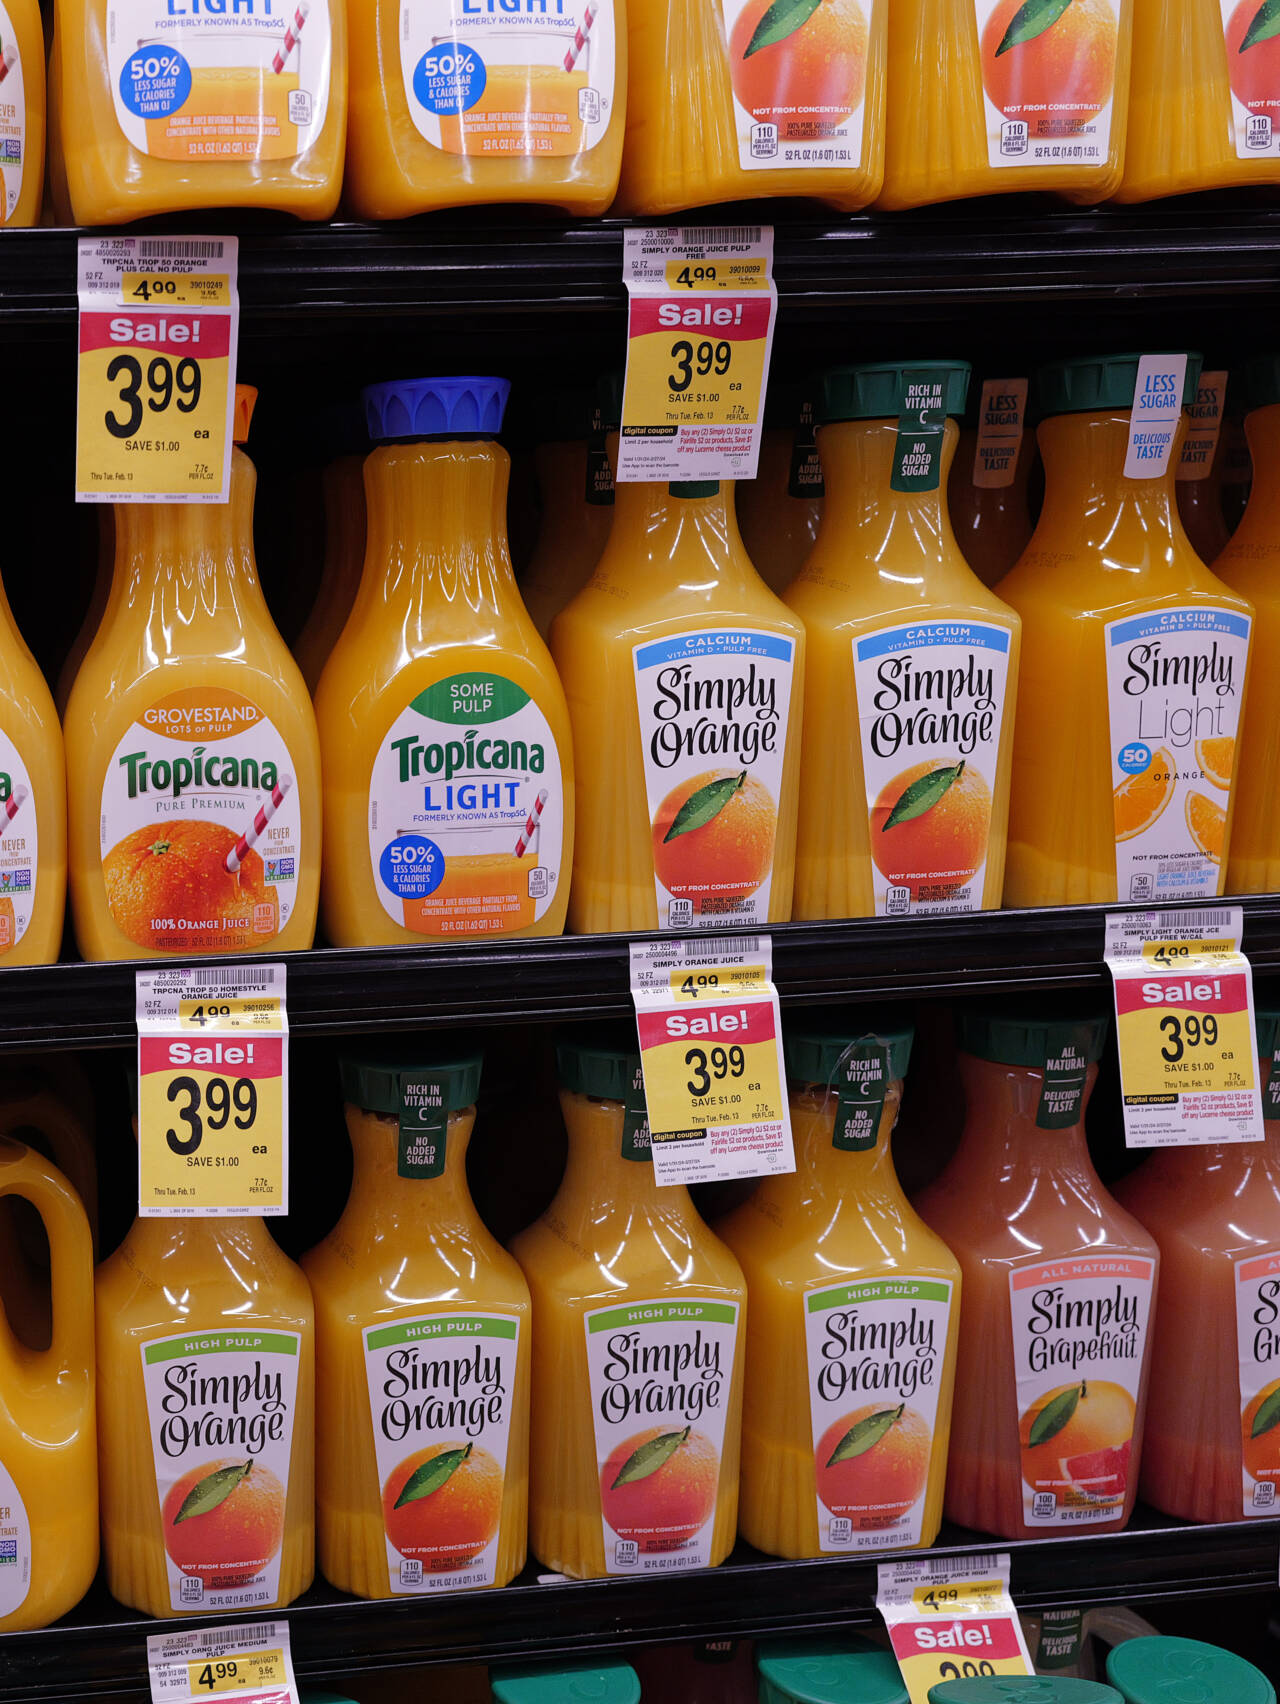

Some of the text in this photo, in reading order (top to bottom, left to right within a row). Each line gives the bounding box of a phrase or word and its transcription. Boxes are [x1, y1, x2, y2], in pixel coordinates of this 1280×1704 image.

[155, 18, 252, 29] FORMERLY KNOWN AS
[131, 56, 180, 79] 50%
[425, 53, 475, 77] 50%
[134, 78, 176, 91] LESS SUGAR
[135, 90, 175, 102] & CALORIES
[140, 101, 170, 112] THAN OJ
[798, 106, 852, 114] CONCENTRATE
[1004, 105, 1022, 113] NOT
[757, 127, 773, 137] 110
[641, 246, 670, 254] SIMPLY
[658, 304, 742, 326] Sale!
[109, 319, 200, 342] Sale!
[909, 384, 942, 396] RICH IN
[1145, 375, 1176, 392] LESS
[905, 397, 942, 409] VITAMIN
[1139, 394, 1176, 409] SUGAR
[919, 410, 929, 424] C
[624, 427, 674, 435] digital coupon
[1133, 433, 1170, 444] DELICIOUS
[125, 441, 180, 451] SAVE $1.00
[913, 443, 926, 453] NO
[1136, 445, 1164, 459] TASTE
[902, 454, 931, 465] ADDED
[901, 465, 929, 476] SUGAR
[686, 636, 751, 647] CALCIUM
[906, 628, 970, 639] CALCIUM
[1123, 641, 1235, 696] Simply
[450, 683, 494, 697] SOME
[874, 654, 996, 711] Simply
[653, 664, 779, 720] Simply
[453, 700, 492, 713] PULP
[144, 707, 259, 725] GROVESTAND
[1139, 697, 1224, 747] Light
[871, 708, 993, 757] Orange
[651, 717, 776, 768] Orange
[391, 730, 544, 783] Tropicana
[1123, 750, 1148, 762] 50
[120, 747, 277, 799] Tropicana
[1154, 771, 1205, 781] ORANGE
[424, 782, 520, 811] LIGHT
[390, 847, 435, 864] 50%
[1142, 981, 1221, 1003] Sale!
[666, 1010, 748, 1036] Sale!
[169, 1043, 254, 1064] Sale!
[1041, 1263, 1131, 1279] ALL NATURAL
[1028, 1285, 1140, 1336] Simply
[821, 1308, 937, 1359] Simply
[185, 1339, 262, 1351] HIGH PULP
[1029, 1331, 1138, 1372] Grapefruit
[604, 1330, 723, 1382] Simply
[383, 1345, 505, 1398] Simply
[818, 1357, 934, 1401] Orange
[162, 1361, 287, 1414] Simply
[601, 1380, 720, 1424] Orange
[381, 1395, 503, 1442] Orange
[160, 1412, 284, 1457] Orange
[914, 1625, 993, 1649] Sale!
